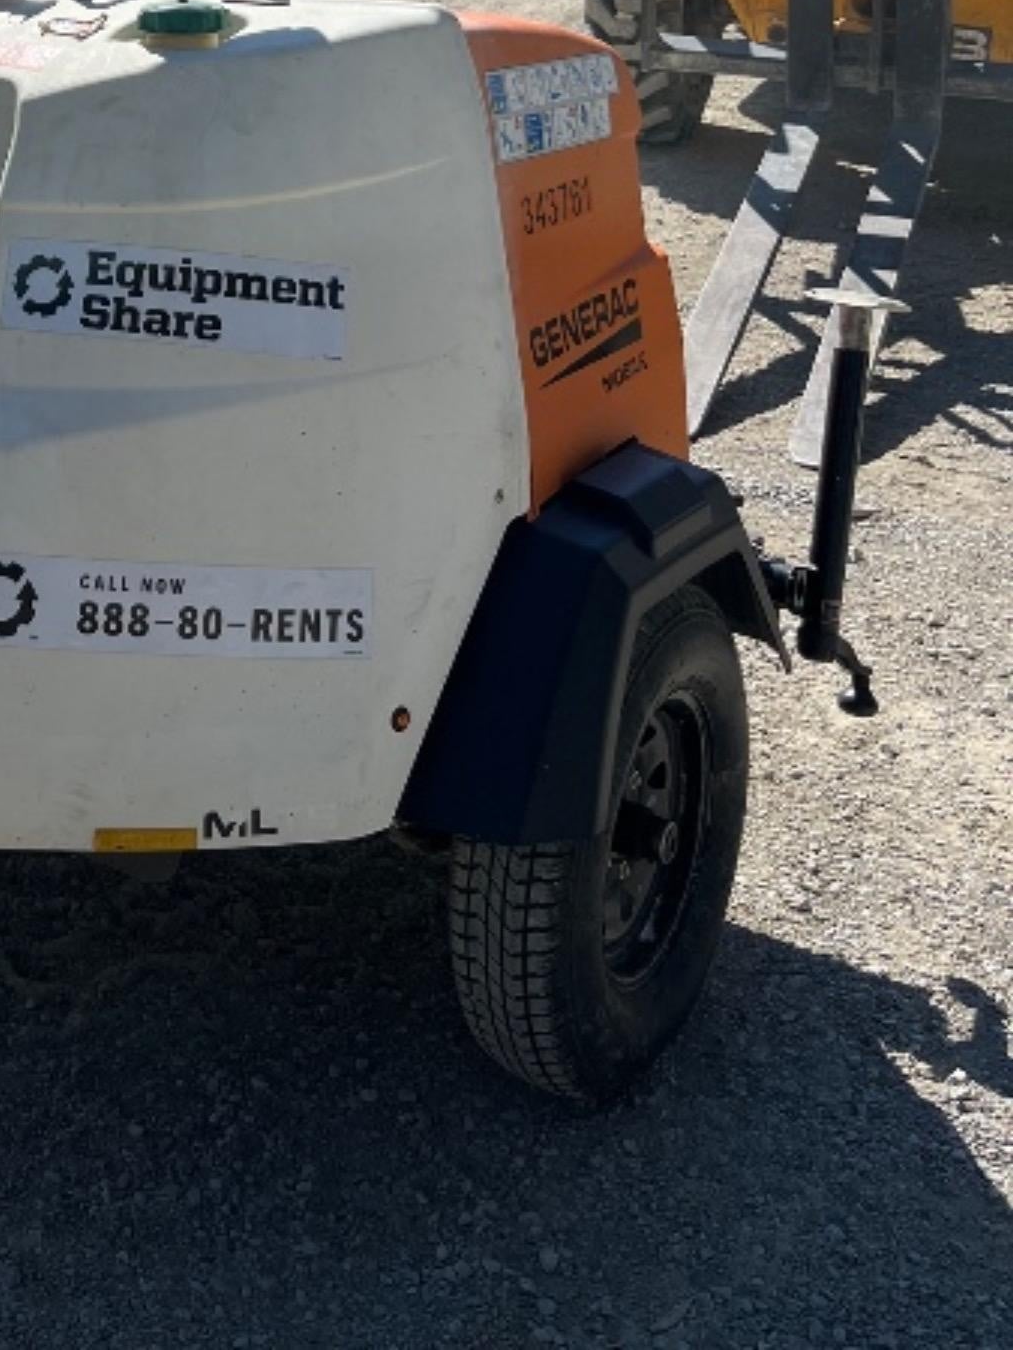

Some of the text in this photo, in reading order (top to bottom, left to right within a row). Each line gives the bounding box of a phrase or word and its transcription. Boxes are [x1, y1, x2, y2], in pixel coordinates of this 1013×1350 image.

[85, 250, 345, 310] Equipment
[79, 293, 223, 341] Share
[529, 277, 640, 369] GENERAC
[78, 573, 187, 595] CALL NOW
[76, 599, 365, 644] 888-80-RENTS
